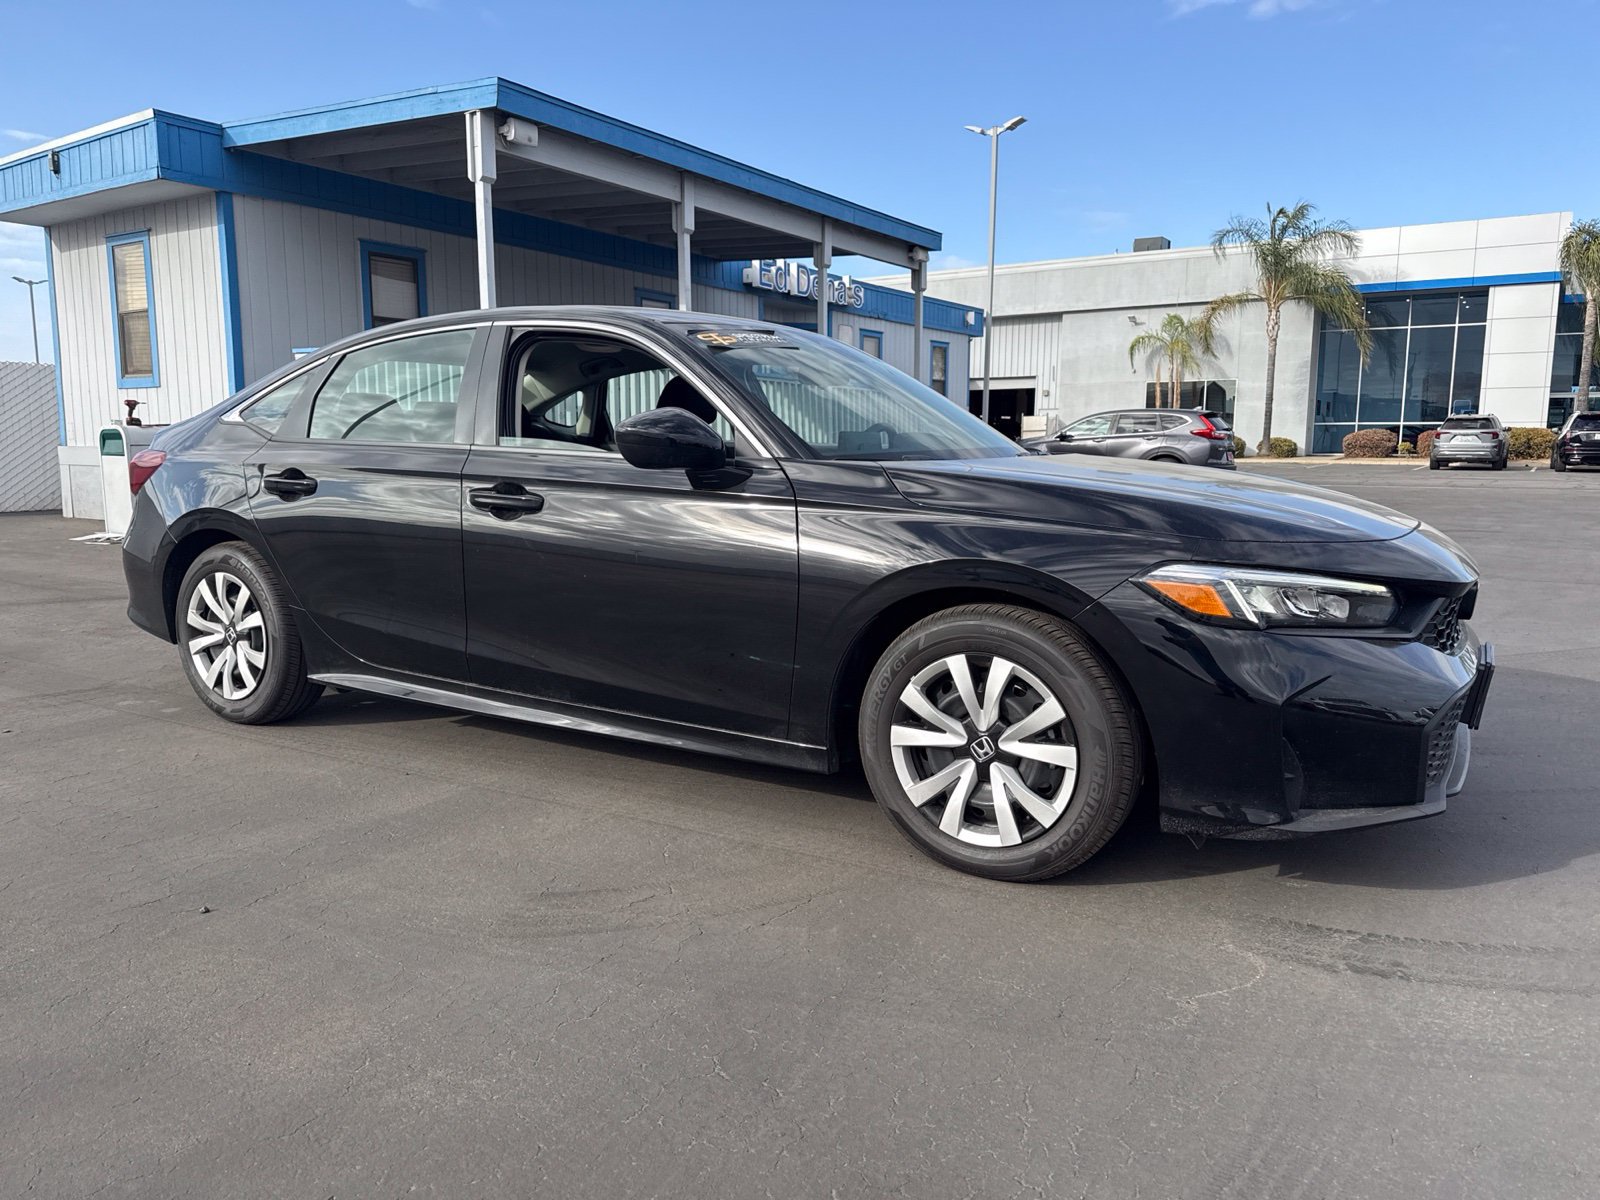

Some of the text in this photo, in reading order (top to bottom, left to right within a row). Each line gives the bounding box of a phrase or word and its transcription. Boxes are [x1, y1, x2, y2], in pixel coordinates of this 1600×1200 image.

[753, 259, 788, 293] Ed
[893, 652, 907, 672] GT
[1045, 766, 1106, 862] Hankook
